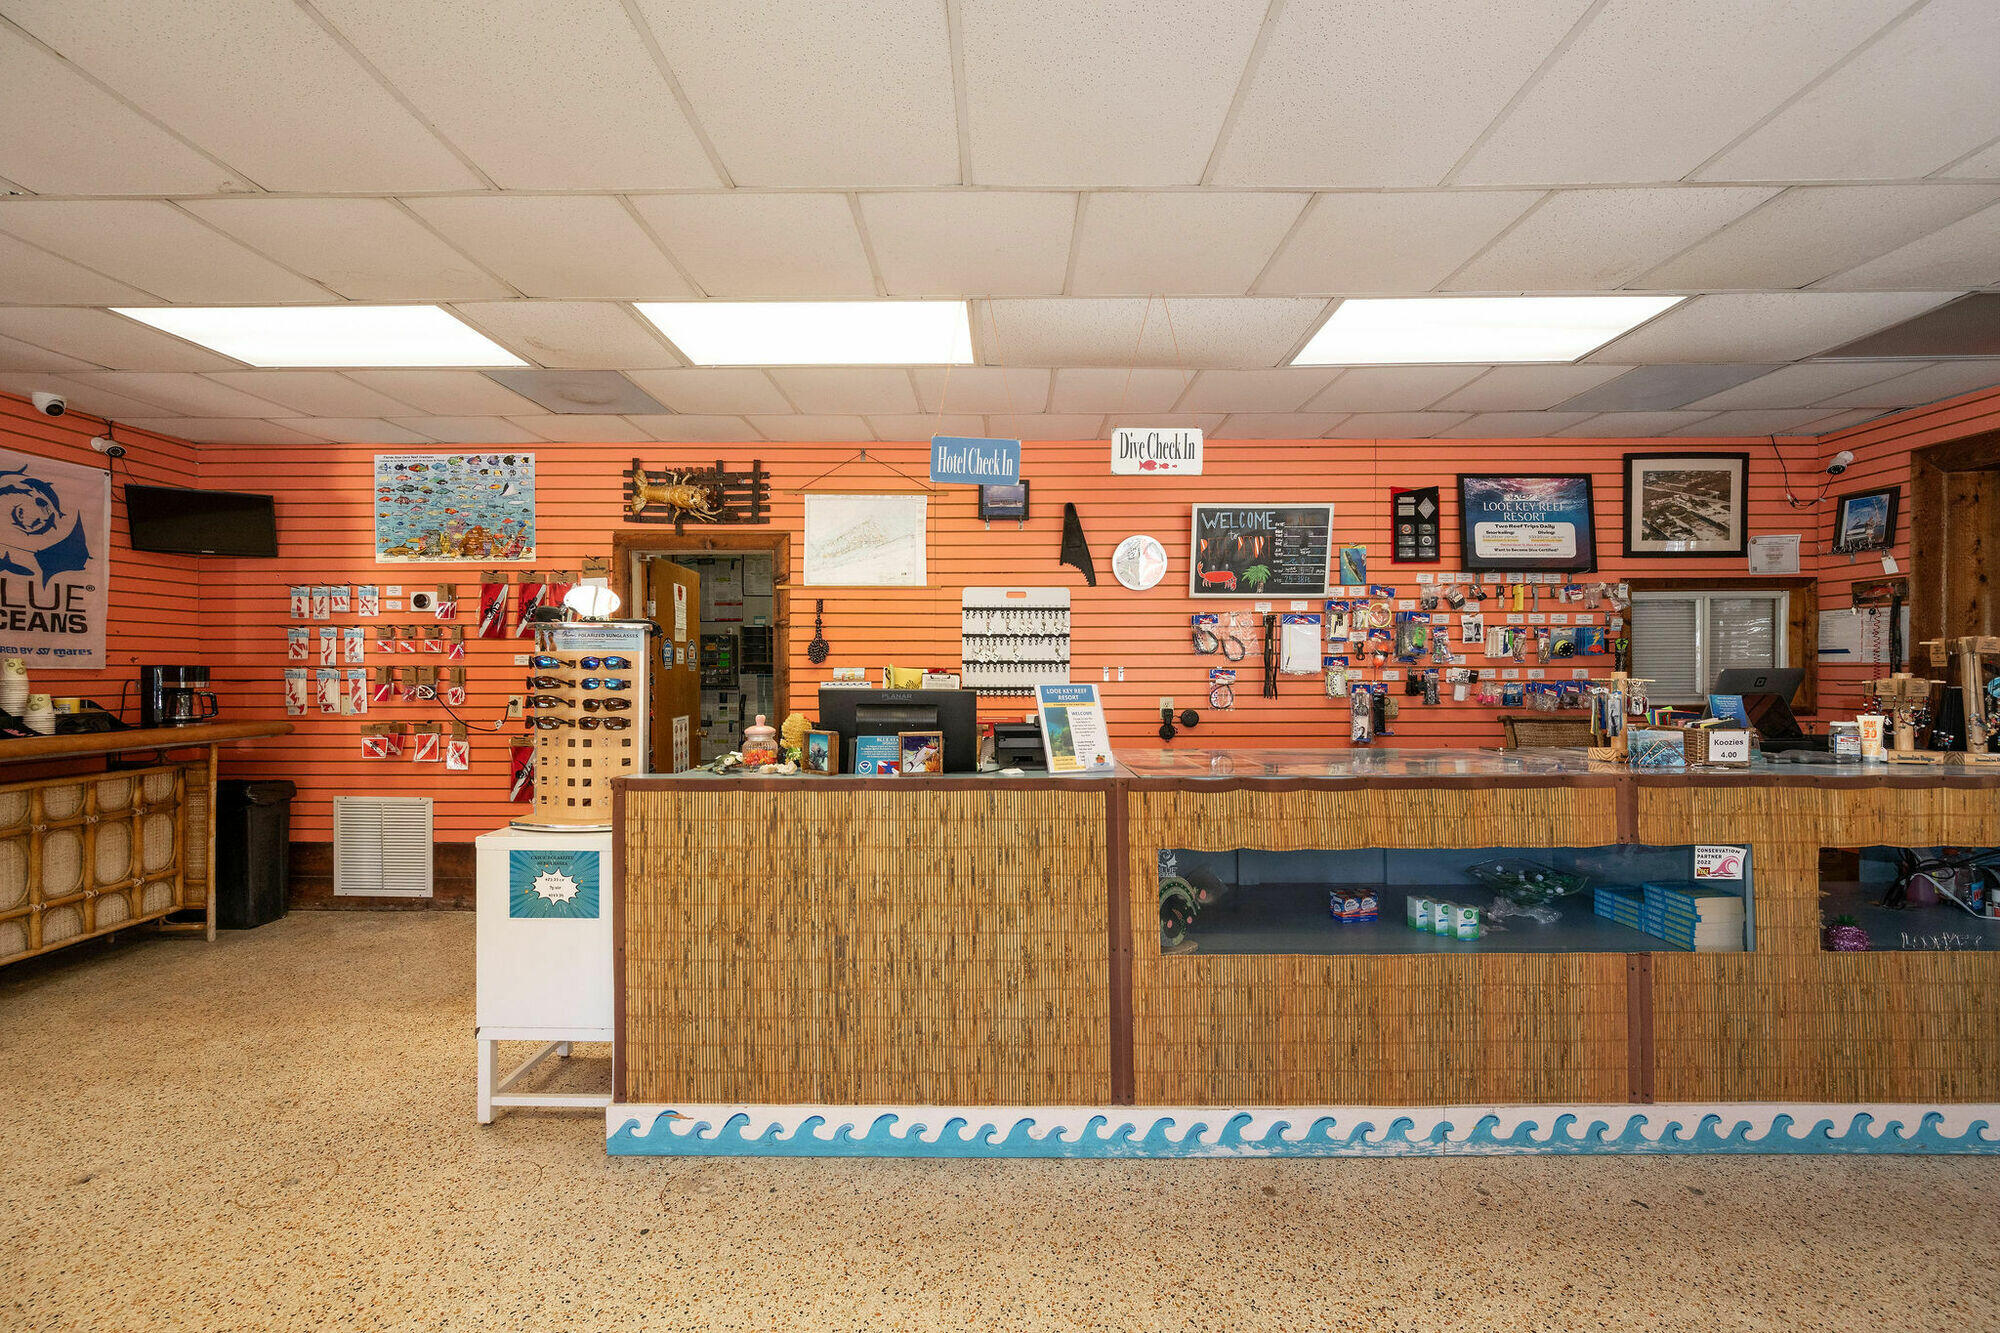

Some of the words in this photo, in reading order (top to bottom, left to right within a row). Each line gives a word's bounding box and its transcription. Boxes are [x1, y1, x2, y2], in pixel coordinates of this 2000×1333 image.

[1120, 432, 1145, 459] Dive
[1147, 432, 1181, 459] Check
[1183, 432, 1195, 459] In
[937, 446, 967, 474] Hotel
[968, 447, 1000, 475] Check
[1001, 449, 1013, 476] In
[1483, 502, 1513, 512] LOOE
[1515, 502, 1535, 512] KEY
[1201, 511, 1277, 530] WELCOME
[1503, 512, 1546, 521] RESORT
[1863, 729, 1877, 739] 30
